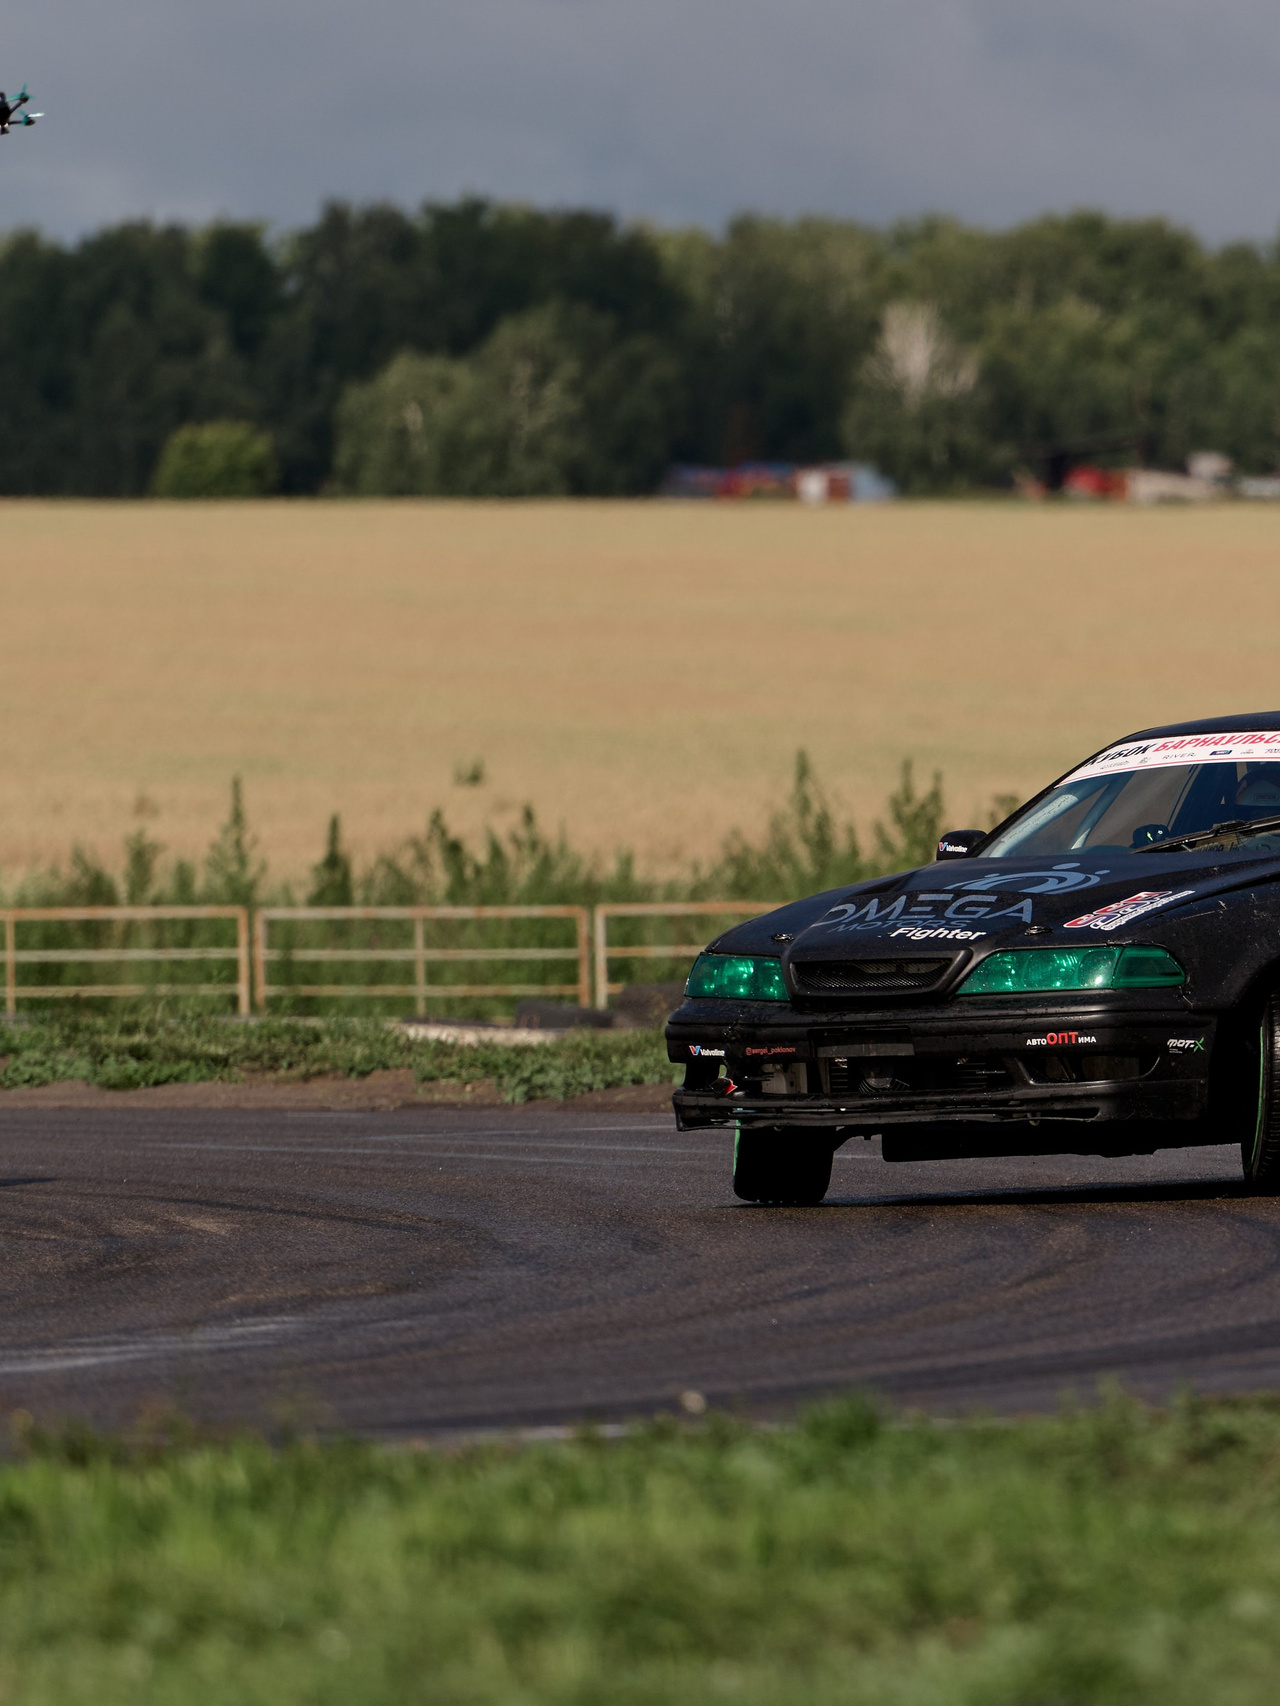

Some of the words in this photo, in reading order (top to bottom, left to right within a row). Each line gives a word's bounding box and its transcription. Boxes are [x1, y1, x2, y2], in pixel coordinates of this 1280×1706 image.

[811, 893, 1033, 928] OMEGA
[828, 919, 972, 933] MOTORS
[890, 926, 987, 940] Fighter
[700, 1049, 725, 1057] Valvoline
